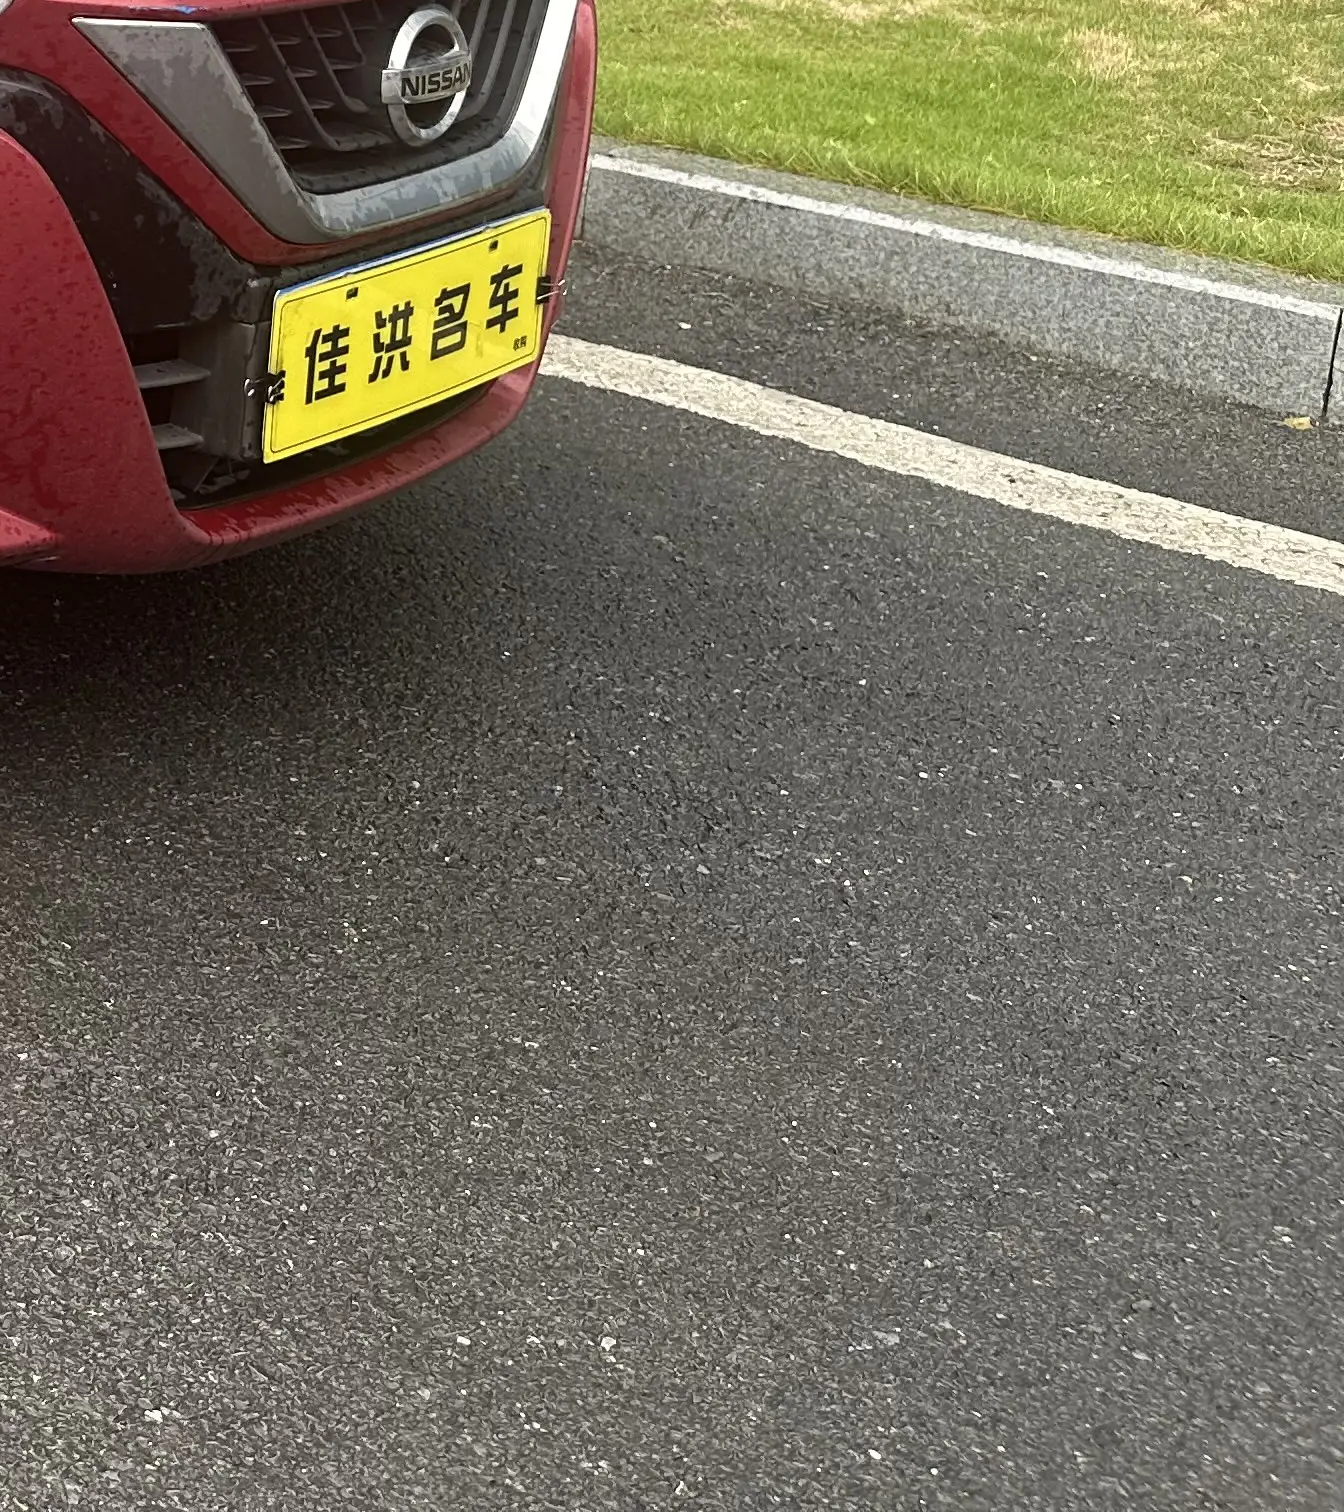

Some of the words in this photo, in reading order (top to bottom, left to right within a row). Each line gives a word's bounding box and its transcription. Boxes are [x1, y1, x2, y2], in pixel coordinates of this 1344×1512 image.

[400, 63, 472, 97] NISSAN
[304, 263, 524, 406] 佳洪名车
